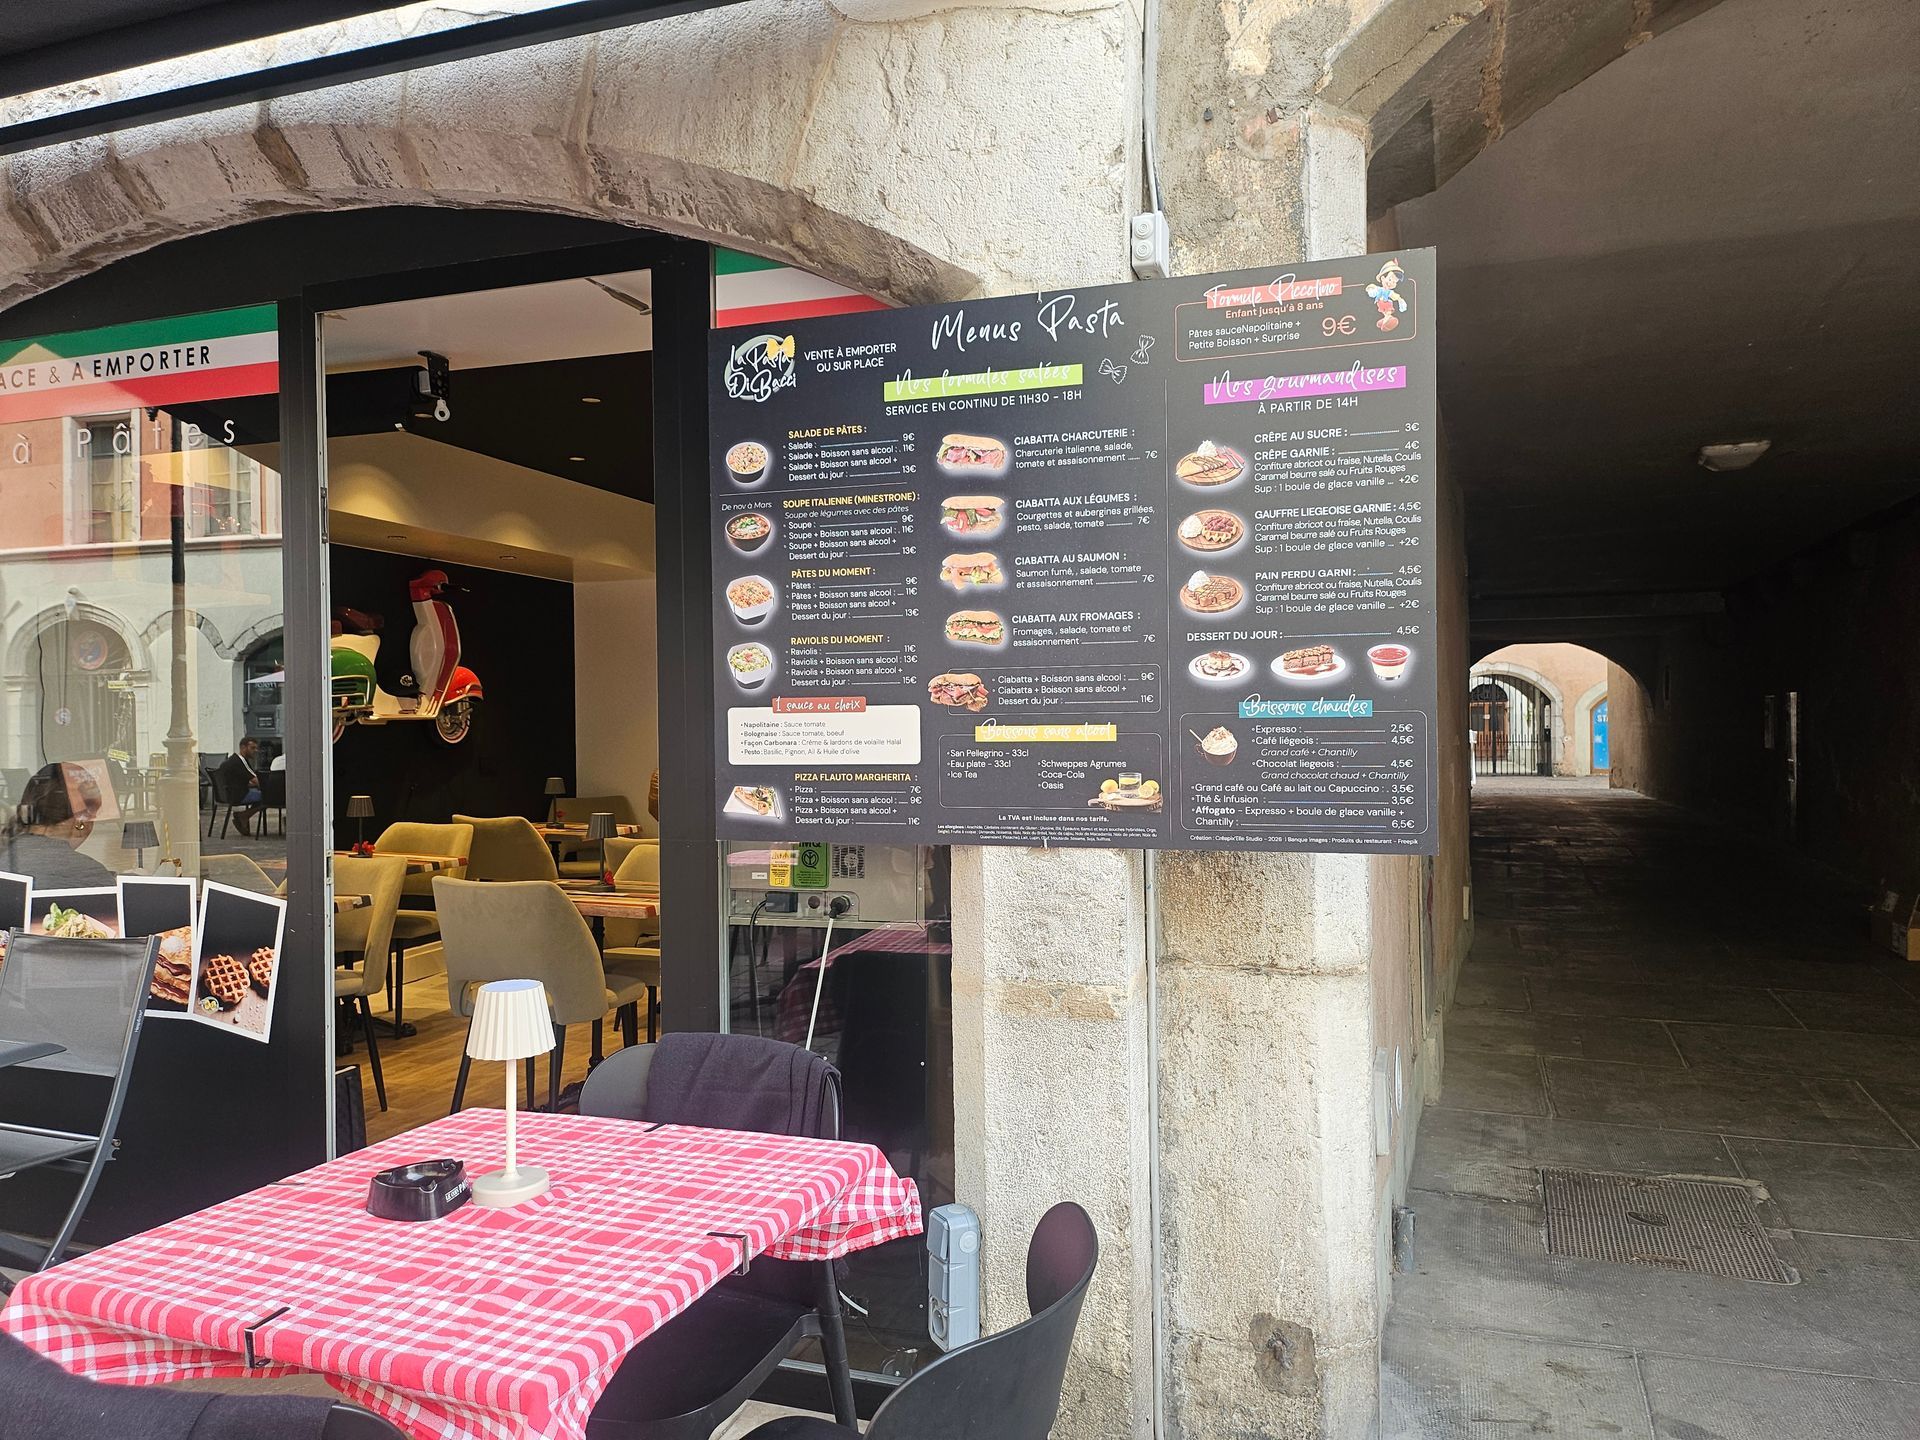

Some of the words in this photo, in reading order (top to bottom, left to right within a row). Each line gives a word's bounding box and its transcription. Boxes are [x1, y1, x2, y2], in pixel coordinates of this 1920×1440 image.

[1204, 284, 1262, 308] Formule
[1268, 273, 1338, 306] Piccolino
[1226, 306, 1257, 319] Enfant
[1297, 302, 1303, 312] 8
[1306, 302, 1323, 310] ans
[932, 310, 1021, 351] Menus
[1038, 295, 1124, 342] Pasta
[1189, 326, 1213, 339] Pâtes
[1216, 320, 1293, 335] sauceNapolitaine
[1322, 315, 1356, 336] 9€
[1189, 339, 1214, 350] Petite
[1217, 336, 1251, 347] Boisson
[1262, 331, 1300, 345] Surprise
[729, 345, 748, 372] La
[804, 350, 833, 361] VENTE
[837, 346, 844, 358] À
[846, 343, 896, 356] EMPORTER
[49, 366, 60, 383] &
[72, 363, 84, 380] A
[94, 345, 210, 377] EMPORTER
[817, 362, 831, 372] OU
[834, 361, 851, 371] SUR
[854, 358, 884, 369] PLACE
[896, 368, 930, 396] Nos
[940, 367, 1009, 394] formules
[1019, 362, 1071, 385] salées
[1212, 370, 1253, 399] Nos
[1258, 360, 1397, 400] gourmandises
[751, 370, 796, 402] Bacci
[885, 403, 928, 416] SERVICE
[932, 401, 945, 412] EN
[951, 397, 998, 411] CONTINU
[1002, 395, 1015, 406] DE
[1019, 393, 1049, 405] 11H30
[1063, 390, 1082, 401] 18H
[1258, 401, 1266, 415] À
[1270, 400, 1311, 413] PARTIR
[1317, 399, 1332, 410] DE
[1336, 397, 1358, 408] 14H
[788, 429, 821, 439] SALADE
[824, 428, 834, 436] DE
[836, 425, 862, 435] PÂTES
[1405, 423, 1420, 432] 3€
[12, 433, 32, 464] à
[77, 420, 235, 458] Pâtes
[1014, 435, 1059, 445] CIABATTA
[1062, 429, 1128, 442] CHARCUTERIE
[1254, 432, 1287, 443] CRÊPE
[1290, 431, 1304, 441] AU
[1307, 428, 1341, 440] SUCRE
[1405, 441, 1419, 450] 4€
[1145, 451, 1157, 459] 7€
[1254, 449, 1287, 461] CRÊPE
[1290, 447, 1329, 459] GARNIE
[722, 503, 731, 511] De
[747, 502, 752, 510] à
[754, 501, 772, 509] Mars
[783, 500, 810, 509] SOUPE
[812, 496, 853, 507] ITALIENNE
[855, 492, 916, 505] (MINESTRONE)
[1016, 498, 1060, 508] CIABATTA
[1063, 496, 1082, 506] AUX
[1085, 493, 1130, 504] LÉGUMES
[1255, 508, 1299, 520] GAUFFRE
[1301, 505, 1352, 517] LIEGEOISE
[1353, 503, 1391, 514] GARNIE
[1399, 502, 1421, 513] 4,5€
[1017, 512, 1062, 522] Courgettes
[1076, 507, 1121, 518] aubergines
[1138, 516, 1150, 525] 7€
[1015, 556, 1060, 566] CIABATTA
[1063, 554, 1075, 563] AU
[1078, 552, 1119, 563] SAUMON
[792, 569, 817, 579] PÂTES
[819, 569, 830, 577] DU
[832, 567, 871, 577] MOMENT
[1255, 571, 1279, 580] PAIN
[1281, 569, 1315, 579] PERDU
[1318, 568, 1352, 578] GARNI
[1399, 564, 1421, 575] 4,5€
[1012, 614, 1057, 624] CIABATTA
[1059, 613, 1078, 622] AUX
[1080, 611, 1133, 621] FROMAGES
[1187, 631, 1231, 642] DESSERT
[1233, 631, 1247, 640] DU
[1250, 630, 1278, 640] JOUR
[1397, 626, 1419, 636] 4,5€
[791, 636, 829, 645] RAVIOLIS
[831, 635, 842, 644] DU
[845, 634, 883, 643] MOMENT
[776, 696, 781, 711] 1
[786, 702, 813, 711] sauce
[835, 698, 861, 710] choix
[1243, 693, 1305, 717] Boissons
[1312, 694, 1367, 718] chaudes
[980, 718, 1038, 740] Boissons
[1043, 727, 1071, 739] sans
[1076, 722, 1111, 740] alcool
[1256, 725, 1296, 735] Expresso
[1391, 724, 1413, 734] 2,5€
[1256, 736, 1276, 745] Café
[1279, 736, 1313, 747] liégeois
[1391, 736, 1414, 745] 4,5€
[950, 749, 964, 757] San
[966, 749, 1003, 759] Pellegrino
[1012, 749, 1028, 757] 33cl
[1261, 748, 1290, 757] Grand
[1292, 747, 1310, 757] café
[1318, 748, 1357, 759] Chantilly
[950, 760, 964, 768] Eau
[966, 760, 986, 769] plate
[994, 760, 1011, 768] 33cl
[1041, 760, 1087, 769] Schweppes
[1090, 760, 1127, 769] Agrumes
[1256, 759, 1297, 768] Chocolat
[1300, 759, 1334, 770] liegeois
[855, 773, 911, 782] MARGHERITA
[951, 771, 963, 779] Ice
[965, 771, 977, 779] Tea
[1042, 771, 1085, 779] Coca-Cola
[1042, 782, 1064, 790] Oasis
[1195, 795, 1211, 804] Thé
[1214, 795, 1221, 803] &
[1224, 795, 1258, 804] Infusion
[1196, 806, 1235, 817] Affogato
[1246, 807, 1286, 817] Expresso
[1296, 807, 1322, 817] boule
[1325, 808, 1336, 817] de
[1339, 808, 1364, 819] glace
[1367, 808, 1396, 817] vanille
